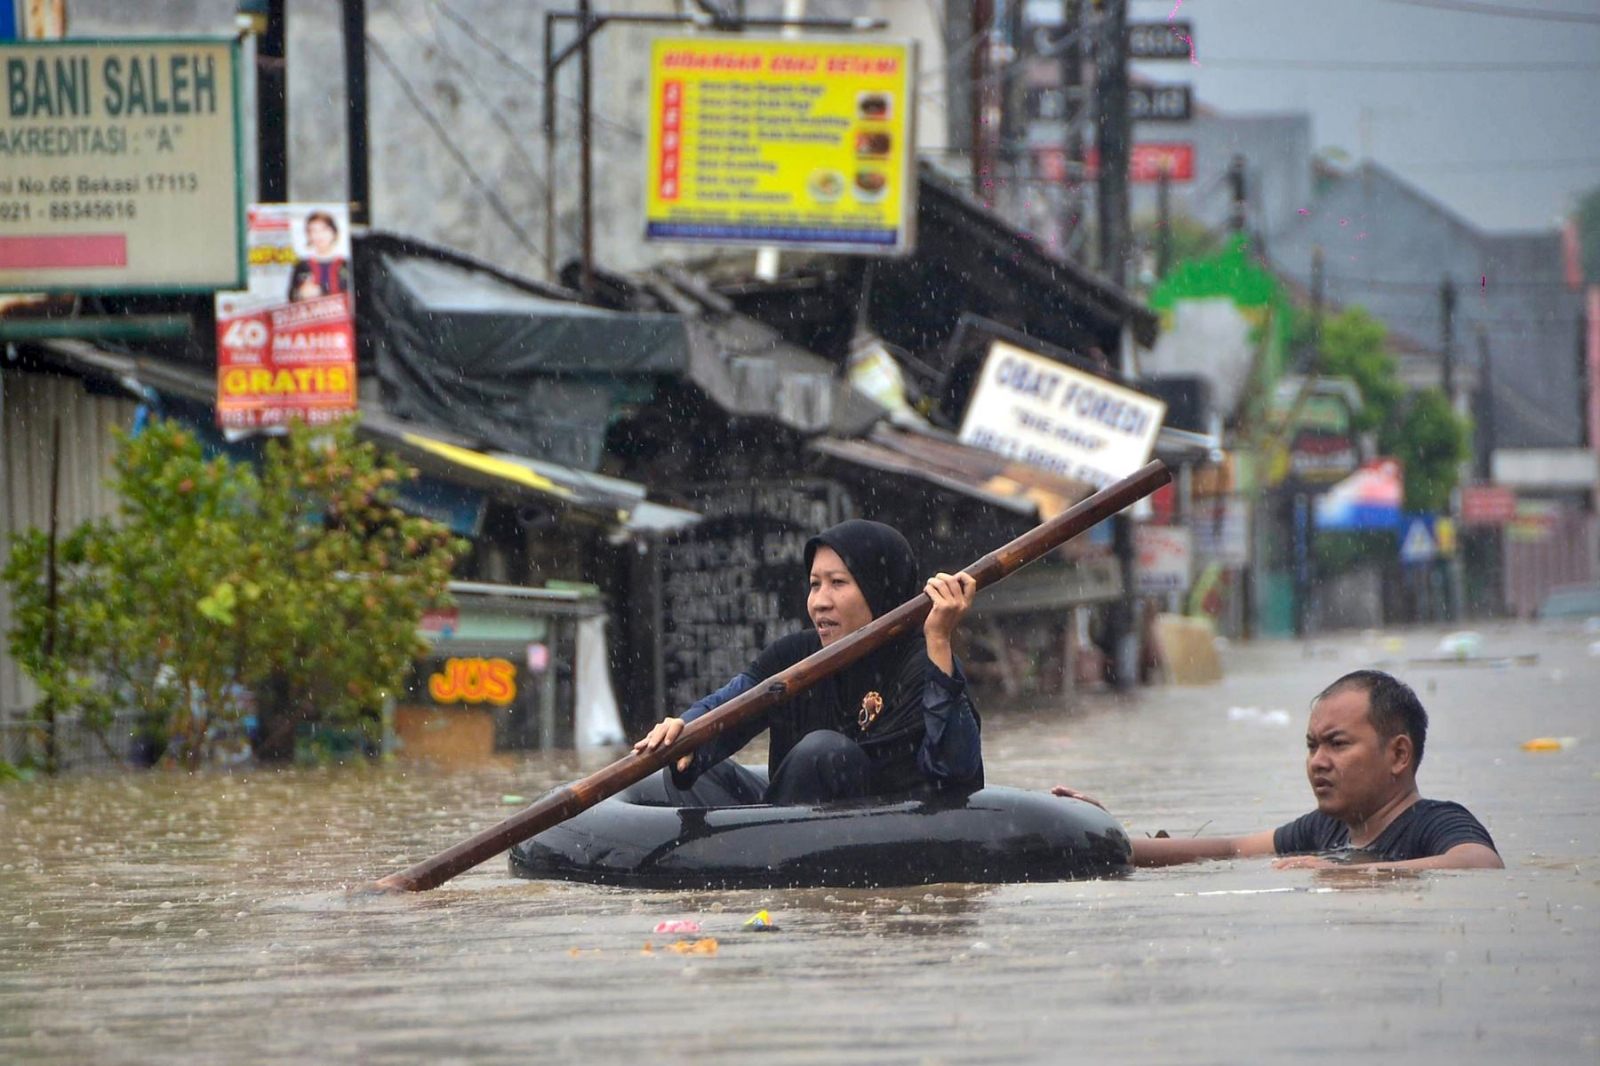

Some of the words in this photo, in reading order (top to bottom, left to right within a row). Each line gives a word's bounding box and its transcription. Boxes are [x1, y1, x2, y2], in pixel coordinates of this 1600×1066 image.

[8, 55, 91, 118] BANI
[103, 53, 217, 116] SALEH
[0, 125, 127, 155] AKREDITASI
[76, 174, 139, 194] Bekasi
[146, 172, 198, 193] 17113
[222, 320, 267, 348] 40
[225, 367, 348, 396] GRATIS
[996, 356, 1061, 402] OBAT
[428, 657, 517, 706] JUS
